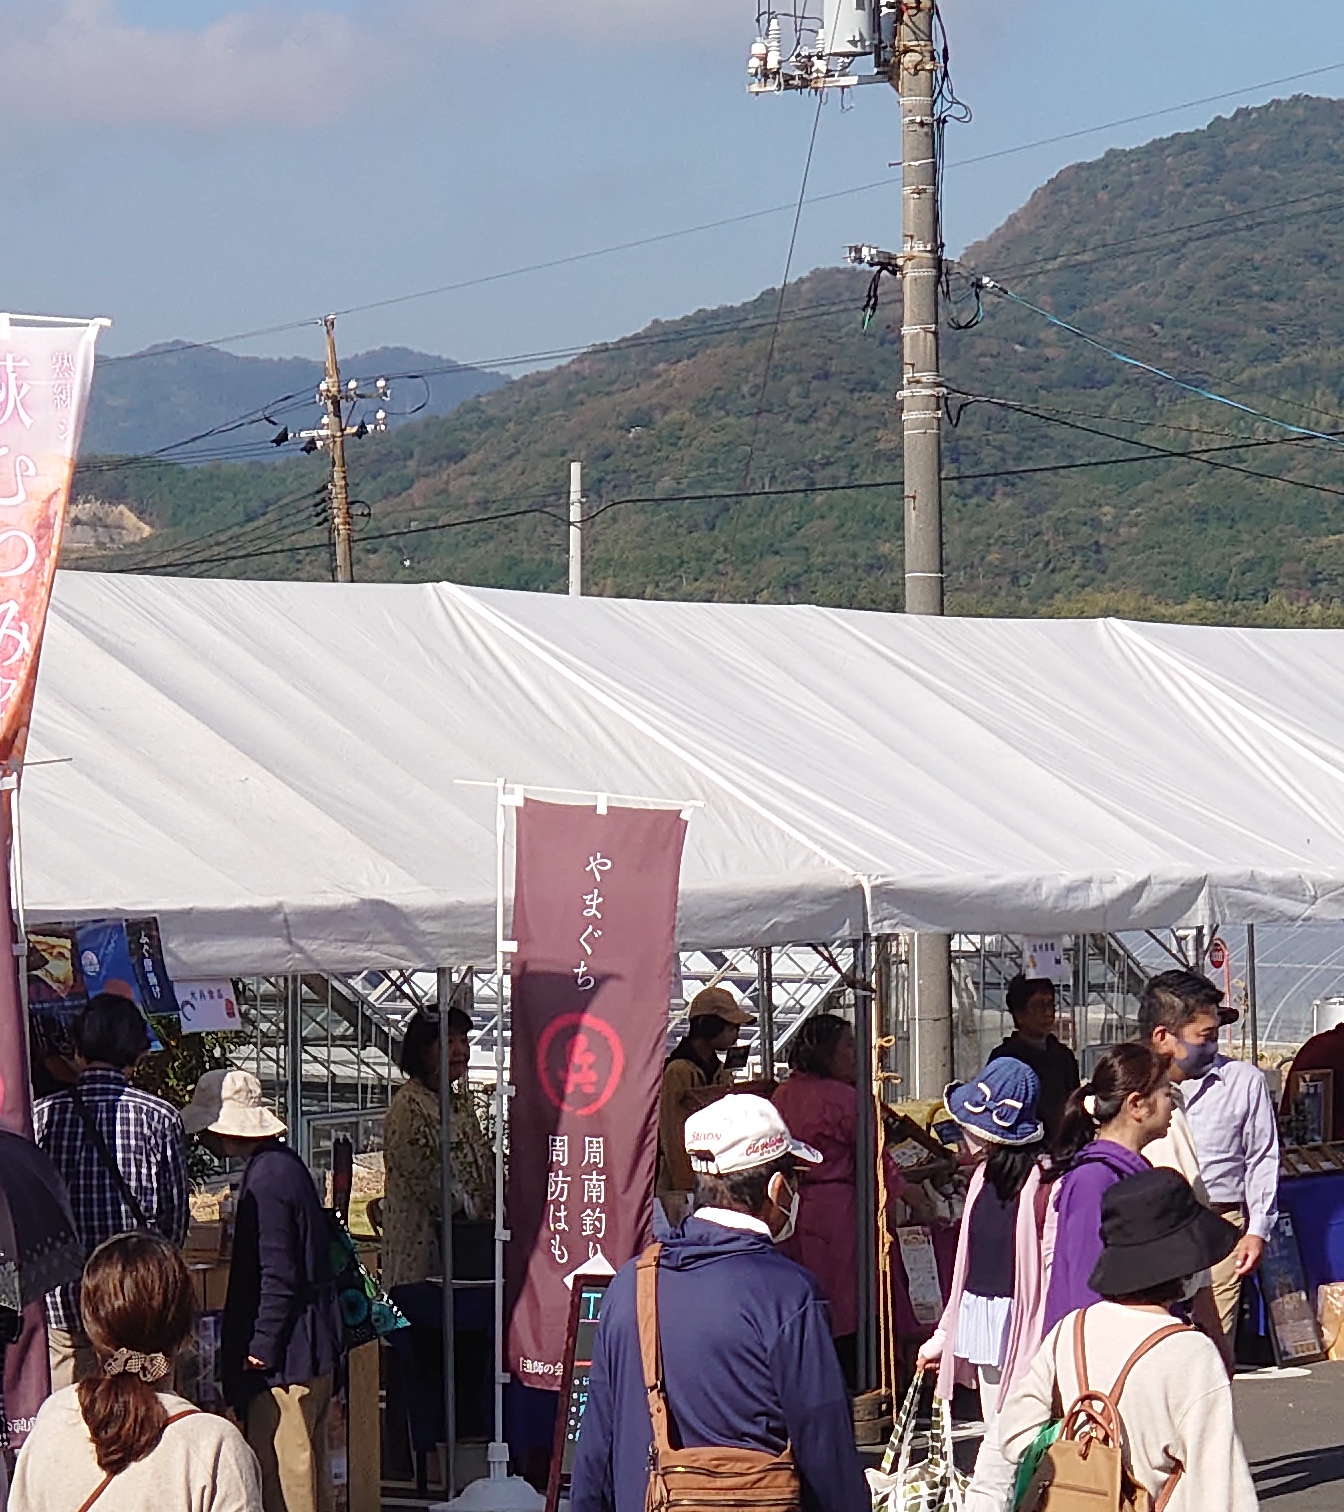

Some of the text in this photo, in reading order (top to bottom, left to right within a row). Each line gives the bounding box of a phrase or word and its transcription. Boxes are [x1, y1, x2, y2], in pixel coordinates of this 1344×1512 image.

[573, 852, 612, 990] やまぐち
[547, 1134, 572, 1265] 周防はも
